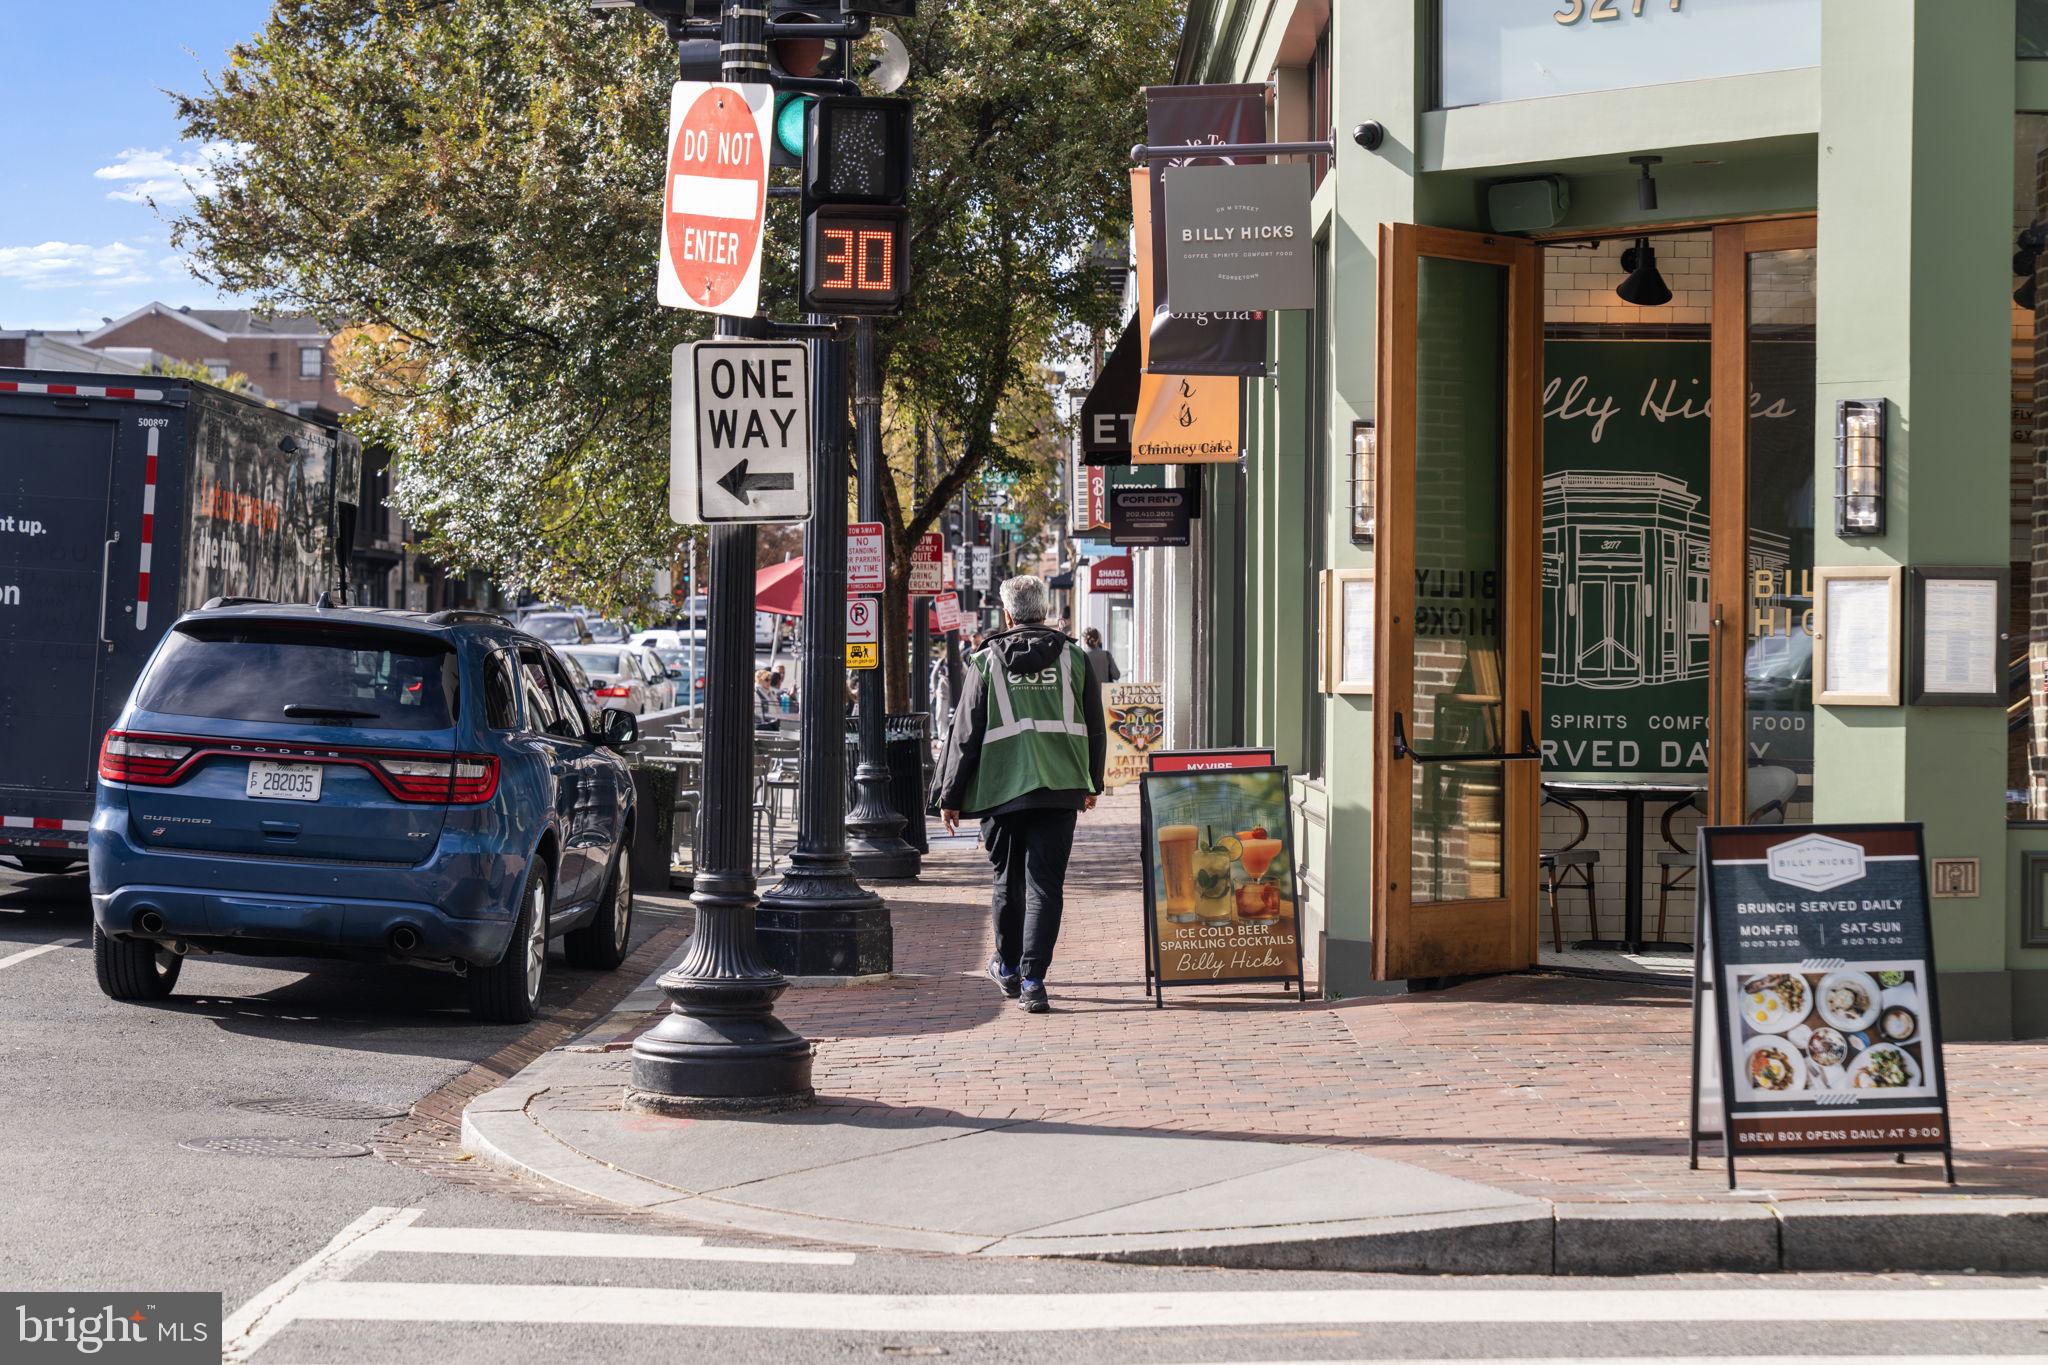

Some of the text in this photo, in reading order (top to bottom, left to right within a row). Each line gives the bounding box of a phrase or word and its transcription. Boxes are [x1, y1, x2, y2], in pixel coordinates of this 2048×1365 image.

[683, 129, 754, 166] DO NOT
[1182, 225, 1294, 242] BILLY HICKS
[683, 227, 740, 266] ENTER
[822, 228, 893, 291] 30
[711, 358, 793, 399] ONE
[708, 409, 797, 449] WAY
[1138, 442, 1233, 457] Chimney Cake
[1122, 493, 1178, 504] FOR RENT
[18, 519, 47, 537] up.
[856, 537, 869, 546] NO
[848, 546, 878, 555] STANDING
[855, 555, 881, 563] PARKING
[848, 564, 879, 573] ANY TIME
[1098, 569, 1126, 578] SHAKES
[1096, 578, 1128, 587] BURGERS
[1754, 569, 1815, 598] BIL
[1550, 714, 1628, 730] SPIRITS
[1752, 716, 1807, 732] FOOD
[230, 744, 340, 758] DODGE
[263, 772, 314, 793] 282035
[142, 814, 213, 825] DURANGO
[407, 831, 430, 839] GT
[1778, 857, 1855, 868] BILLY HICKS
[1737, 899, 1903, 915] BRUNCH SERVED DAILY
[1175, 924, 1269, 939] ICE COLD BEER
[1740, 922, 1902, 937] MON-FRI SAT-SUN
[1160, 934, 1295, 951] SPARKLING COCKTAILS
[1176, 948, 1283, 978] Billy Hicks
[1739, 1131, 1774, 1143] BREW
[1778, 1131, 1803, 1141] BOX
[1806, 1129, 1847, 1141] OPENS
[1850, 1129, 1885, 1140] DAILY
[1889, 1128, 1904, 1138] AT
